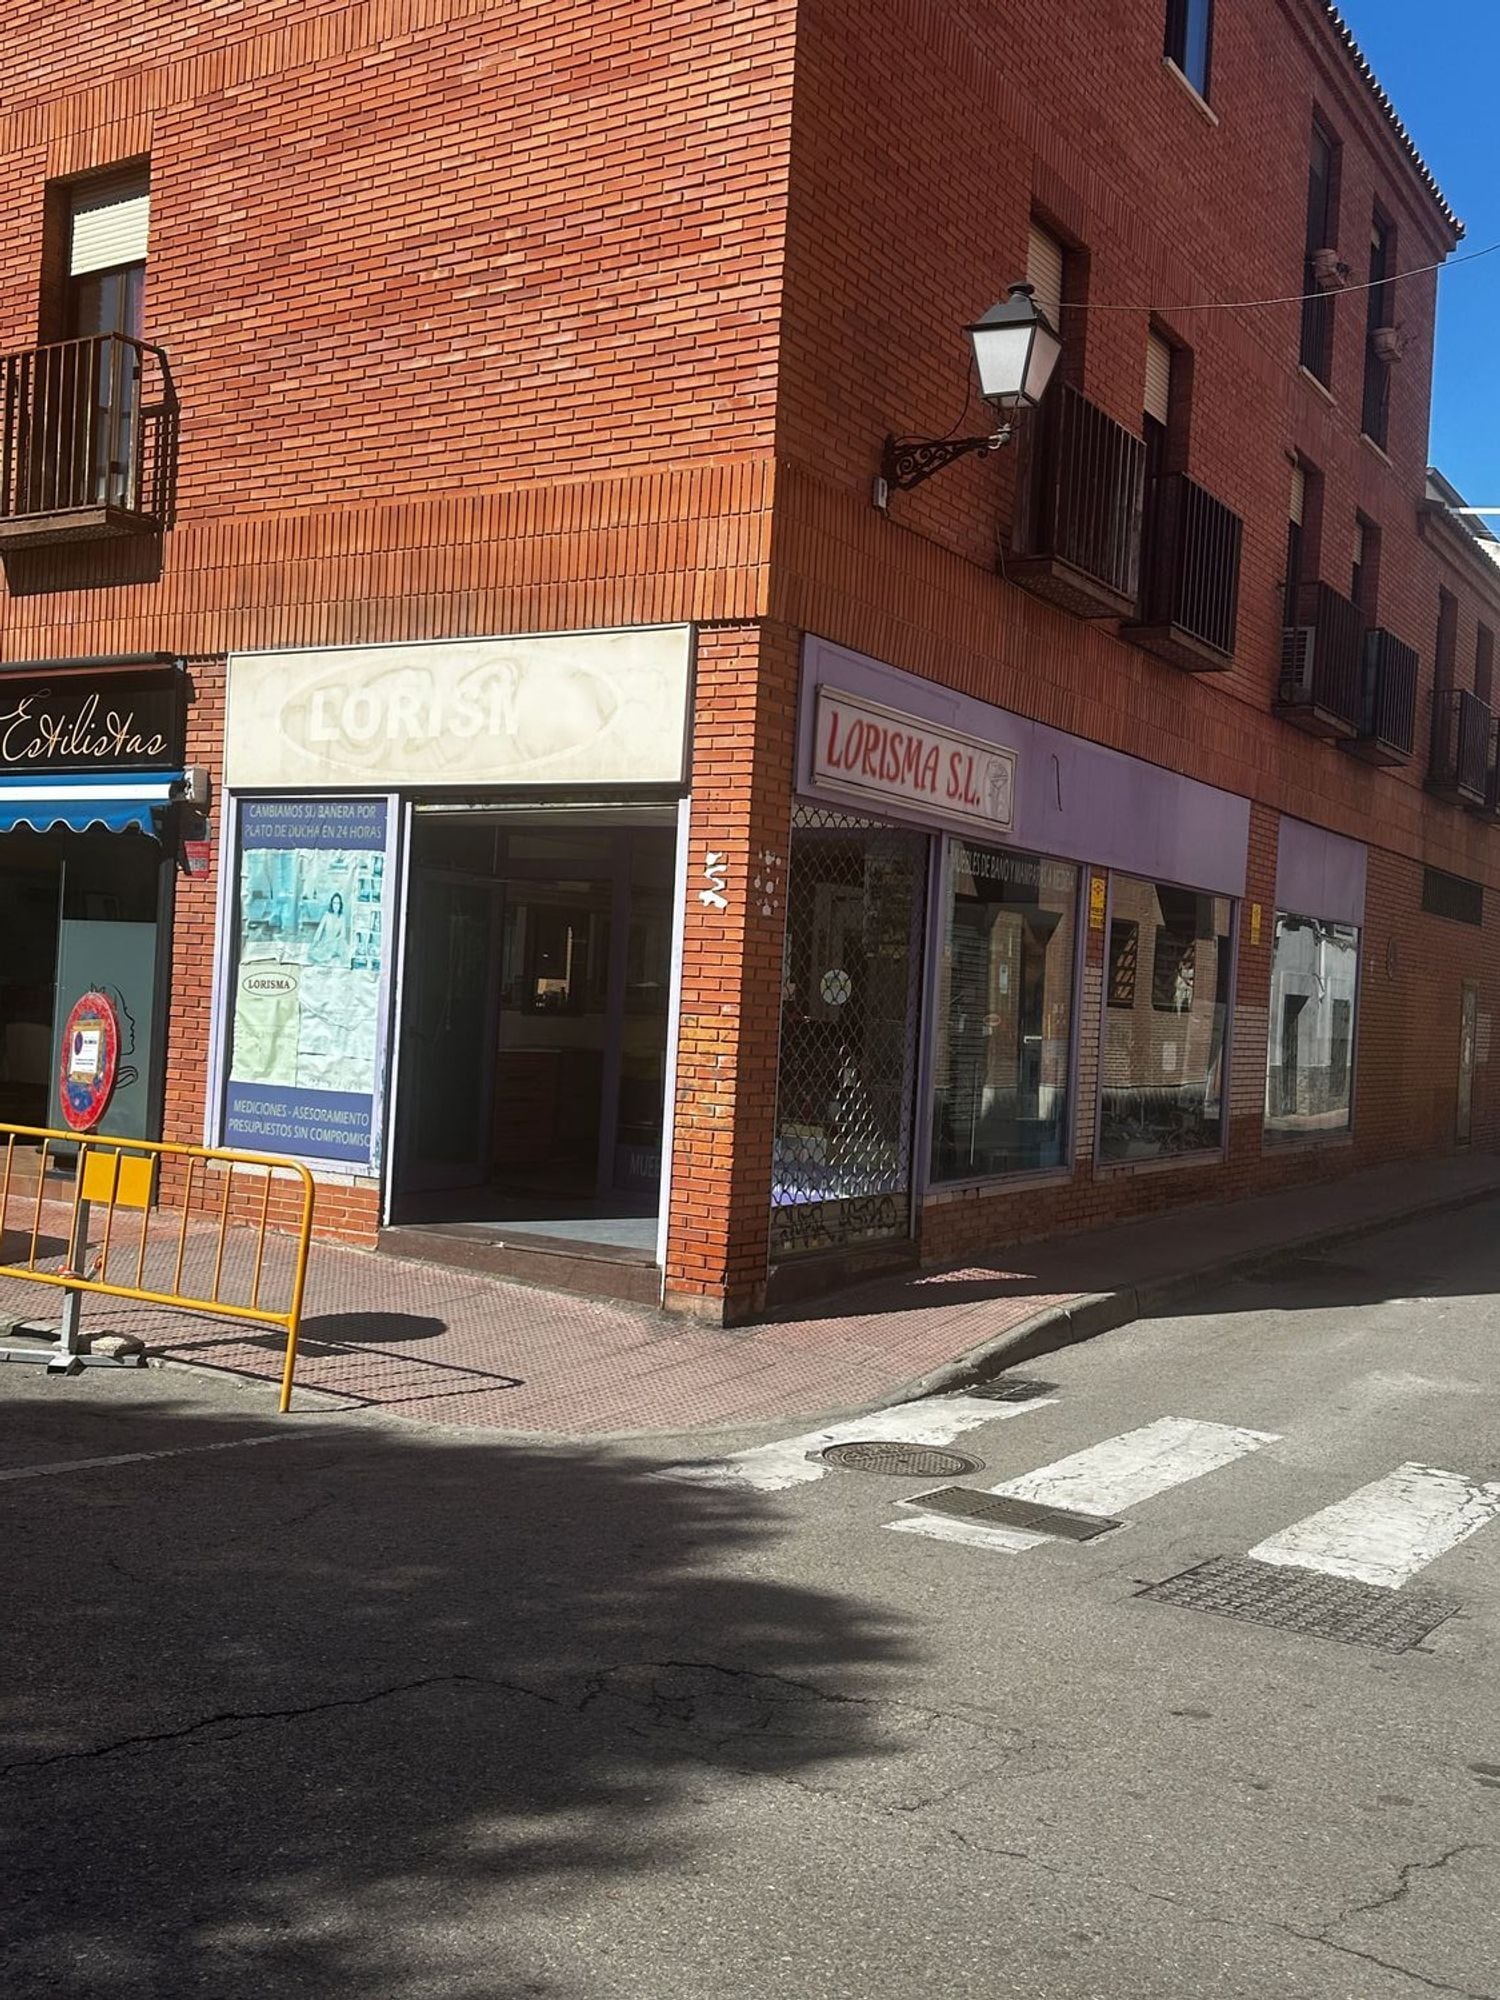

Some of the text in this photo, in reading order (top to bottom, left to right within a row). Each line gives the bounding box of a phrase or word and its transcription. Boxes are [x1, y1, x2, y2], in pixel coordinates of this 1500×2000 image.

[1, 692, 167, 761] Estilistas
[827, 711, 980, 805] LORISMA S.L.
[250, 805, 303, 818] CAMBIAMOS
[305, 805, 316, 818] SU
[357, 805, 377, 819] POR
[245, 824, 381, 839] PLATO DE DUCHA EN 24 HORAS
[248, 979, 290, 989] LORISMA
[234, 1099, 287, 1117] MEDICIONES
[292, 1106, 369, 1126] ASESORAMIENTO
[228, 1118, 292, 1138] PRESUPUESTOS
[294, 1126, 308, 1140] SIN
